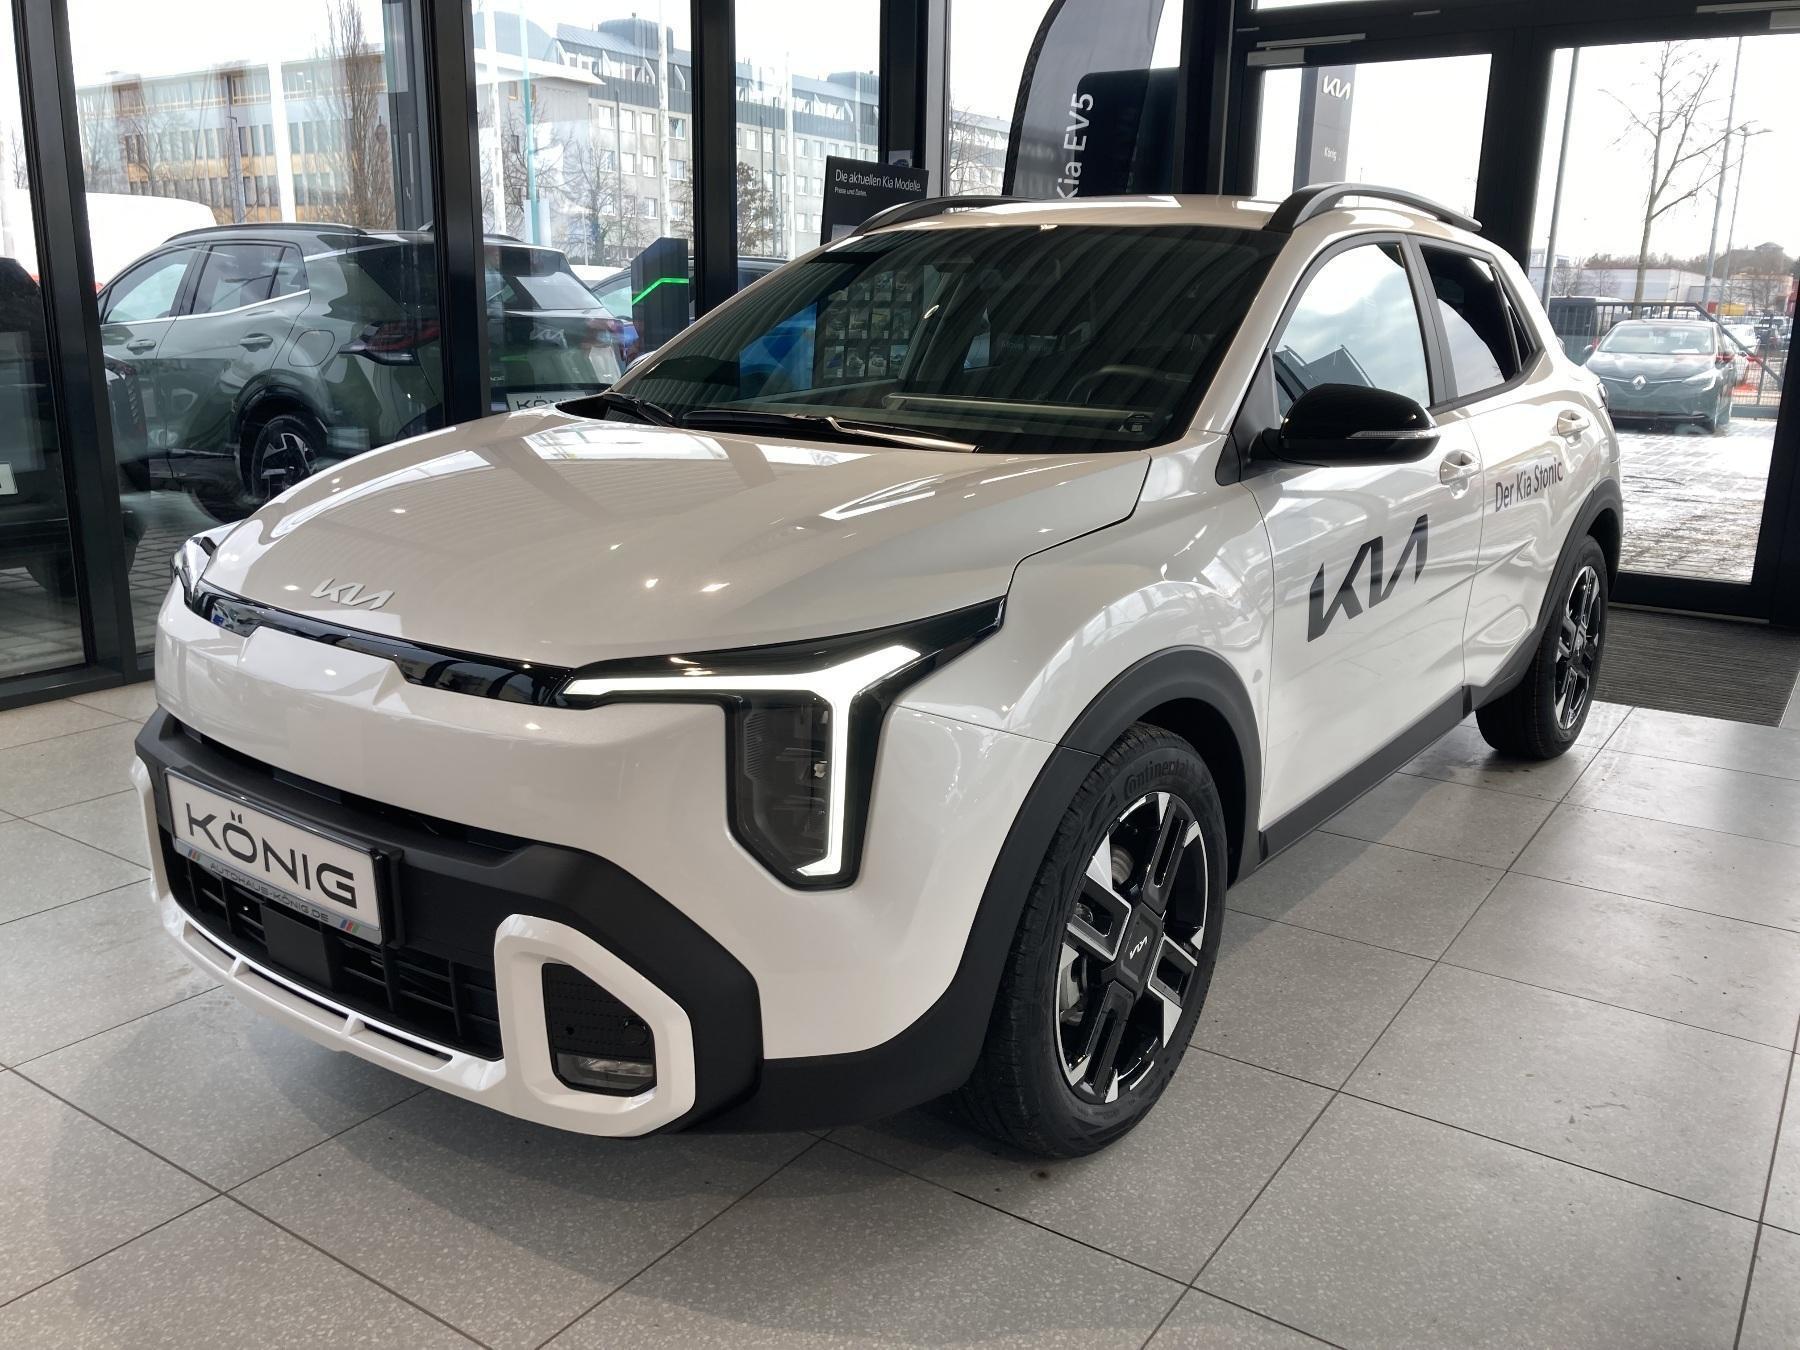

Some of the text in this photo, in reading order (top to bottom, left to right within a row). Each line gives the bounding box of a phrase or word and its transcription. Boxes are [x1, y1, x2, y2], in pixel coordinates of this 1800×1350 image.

[1056, 93, 1094, 199] Kia EV5
[835, 169, 848, 182] Die
[849, 171, 881, 187] aktuellen
[882, 175, 894, 189] Kia
[1495, 457, 1563, 513] Der Kia Stonic
[1124, 759, 1189, 798] Continental
[185, 802, 357, 909] KÖNIG
[210, 862, 329, 922] AUTOHAUS-KÖNIG.DE
